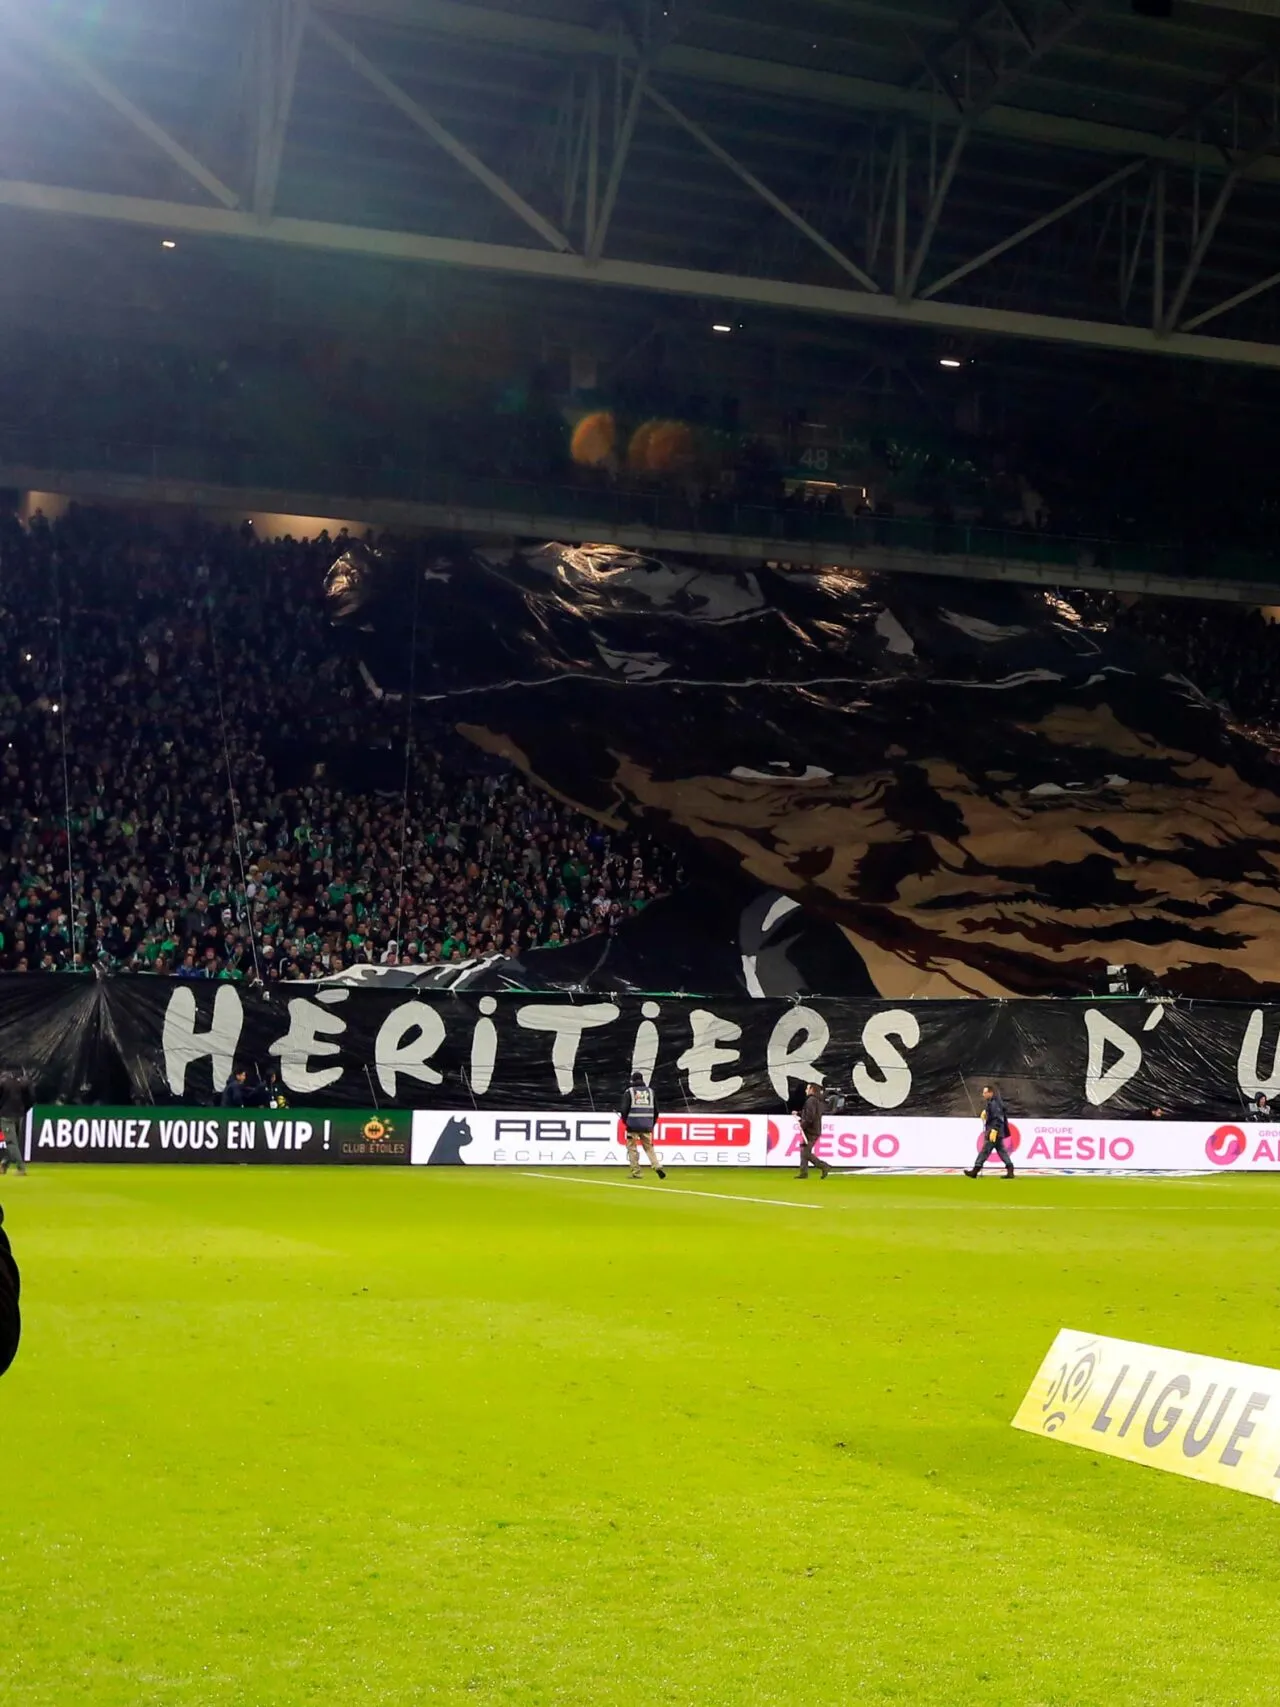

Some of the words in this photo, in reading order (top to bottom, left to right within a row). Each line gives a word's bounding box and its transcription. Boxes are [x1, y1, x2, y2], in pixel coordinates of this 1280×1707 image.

[799, 448, 829, 471] 48
[38, 1118, 151, 1149] ABONNEZ
[159, 1120, 219, 1149] VOUS
[226, 1120, 256, 1150] EN
[263, 1120, 313, 1150] VIP
[323, 1120, 331, 1150] !
[494, 1119, 611, 1142] ABC
[1034, 1126, 1073, 1134] GROUPE
[493, 1148, 752, 1163] ÉCHAFADAGES
[1026, 1135, 1135, 1162] AESIO
[1092, 1364, 1272, 1467] LIGUE
